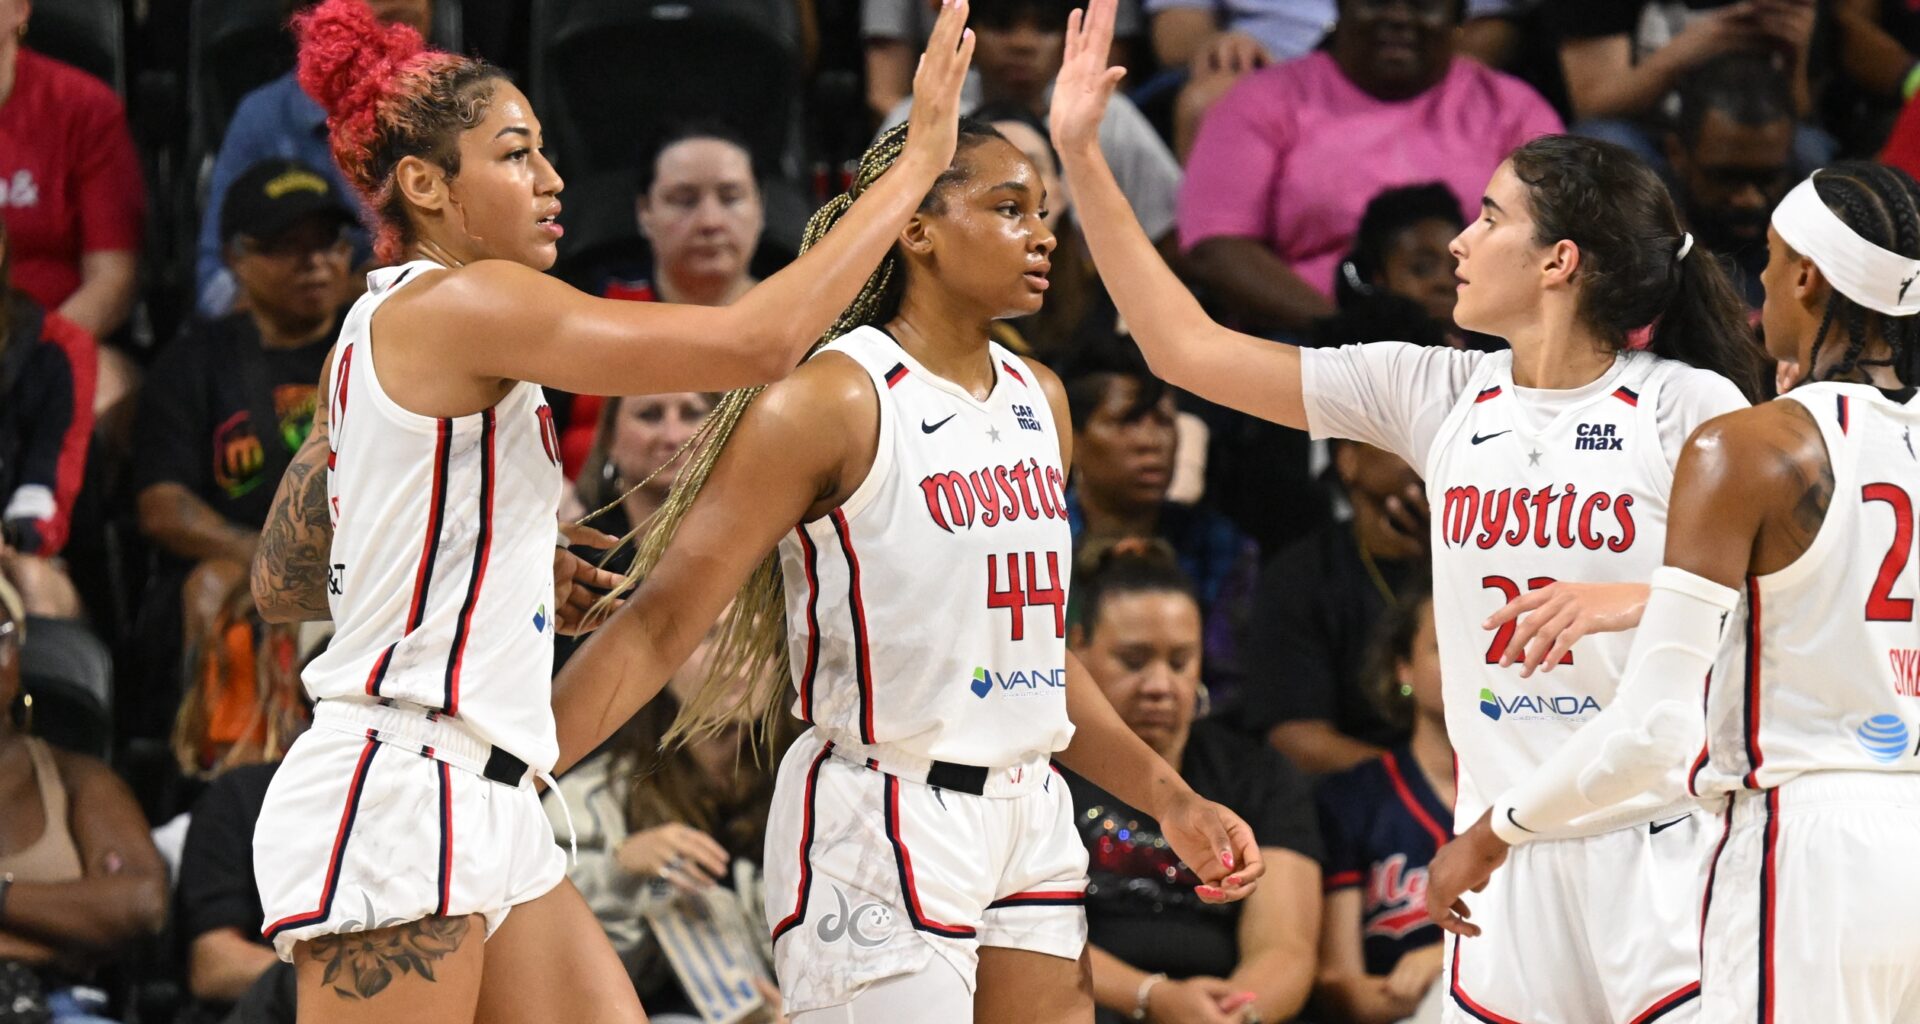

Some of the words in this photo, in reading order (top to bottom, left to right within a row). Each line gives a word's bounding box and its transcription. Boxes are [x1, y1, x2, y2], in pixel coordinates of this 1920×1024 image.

[1011, 404, 1034, 418] CAR
[1017, 417, 1043, 432] max
[1576, 423, 1616, 436] CAR
[1575, 437, 1624, 451] max
[918, 457, 1068, 534] mystic
[1861, 482, 1920, 622] 2
[987, 551, 1065, 641] 44
[1498, 695, 1602, 715] VANDA
